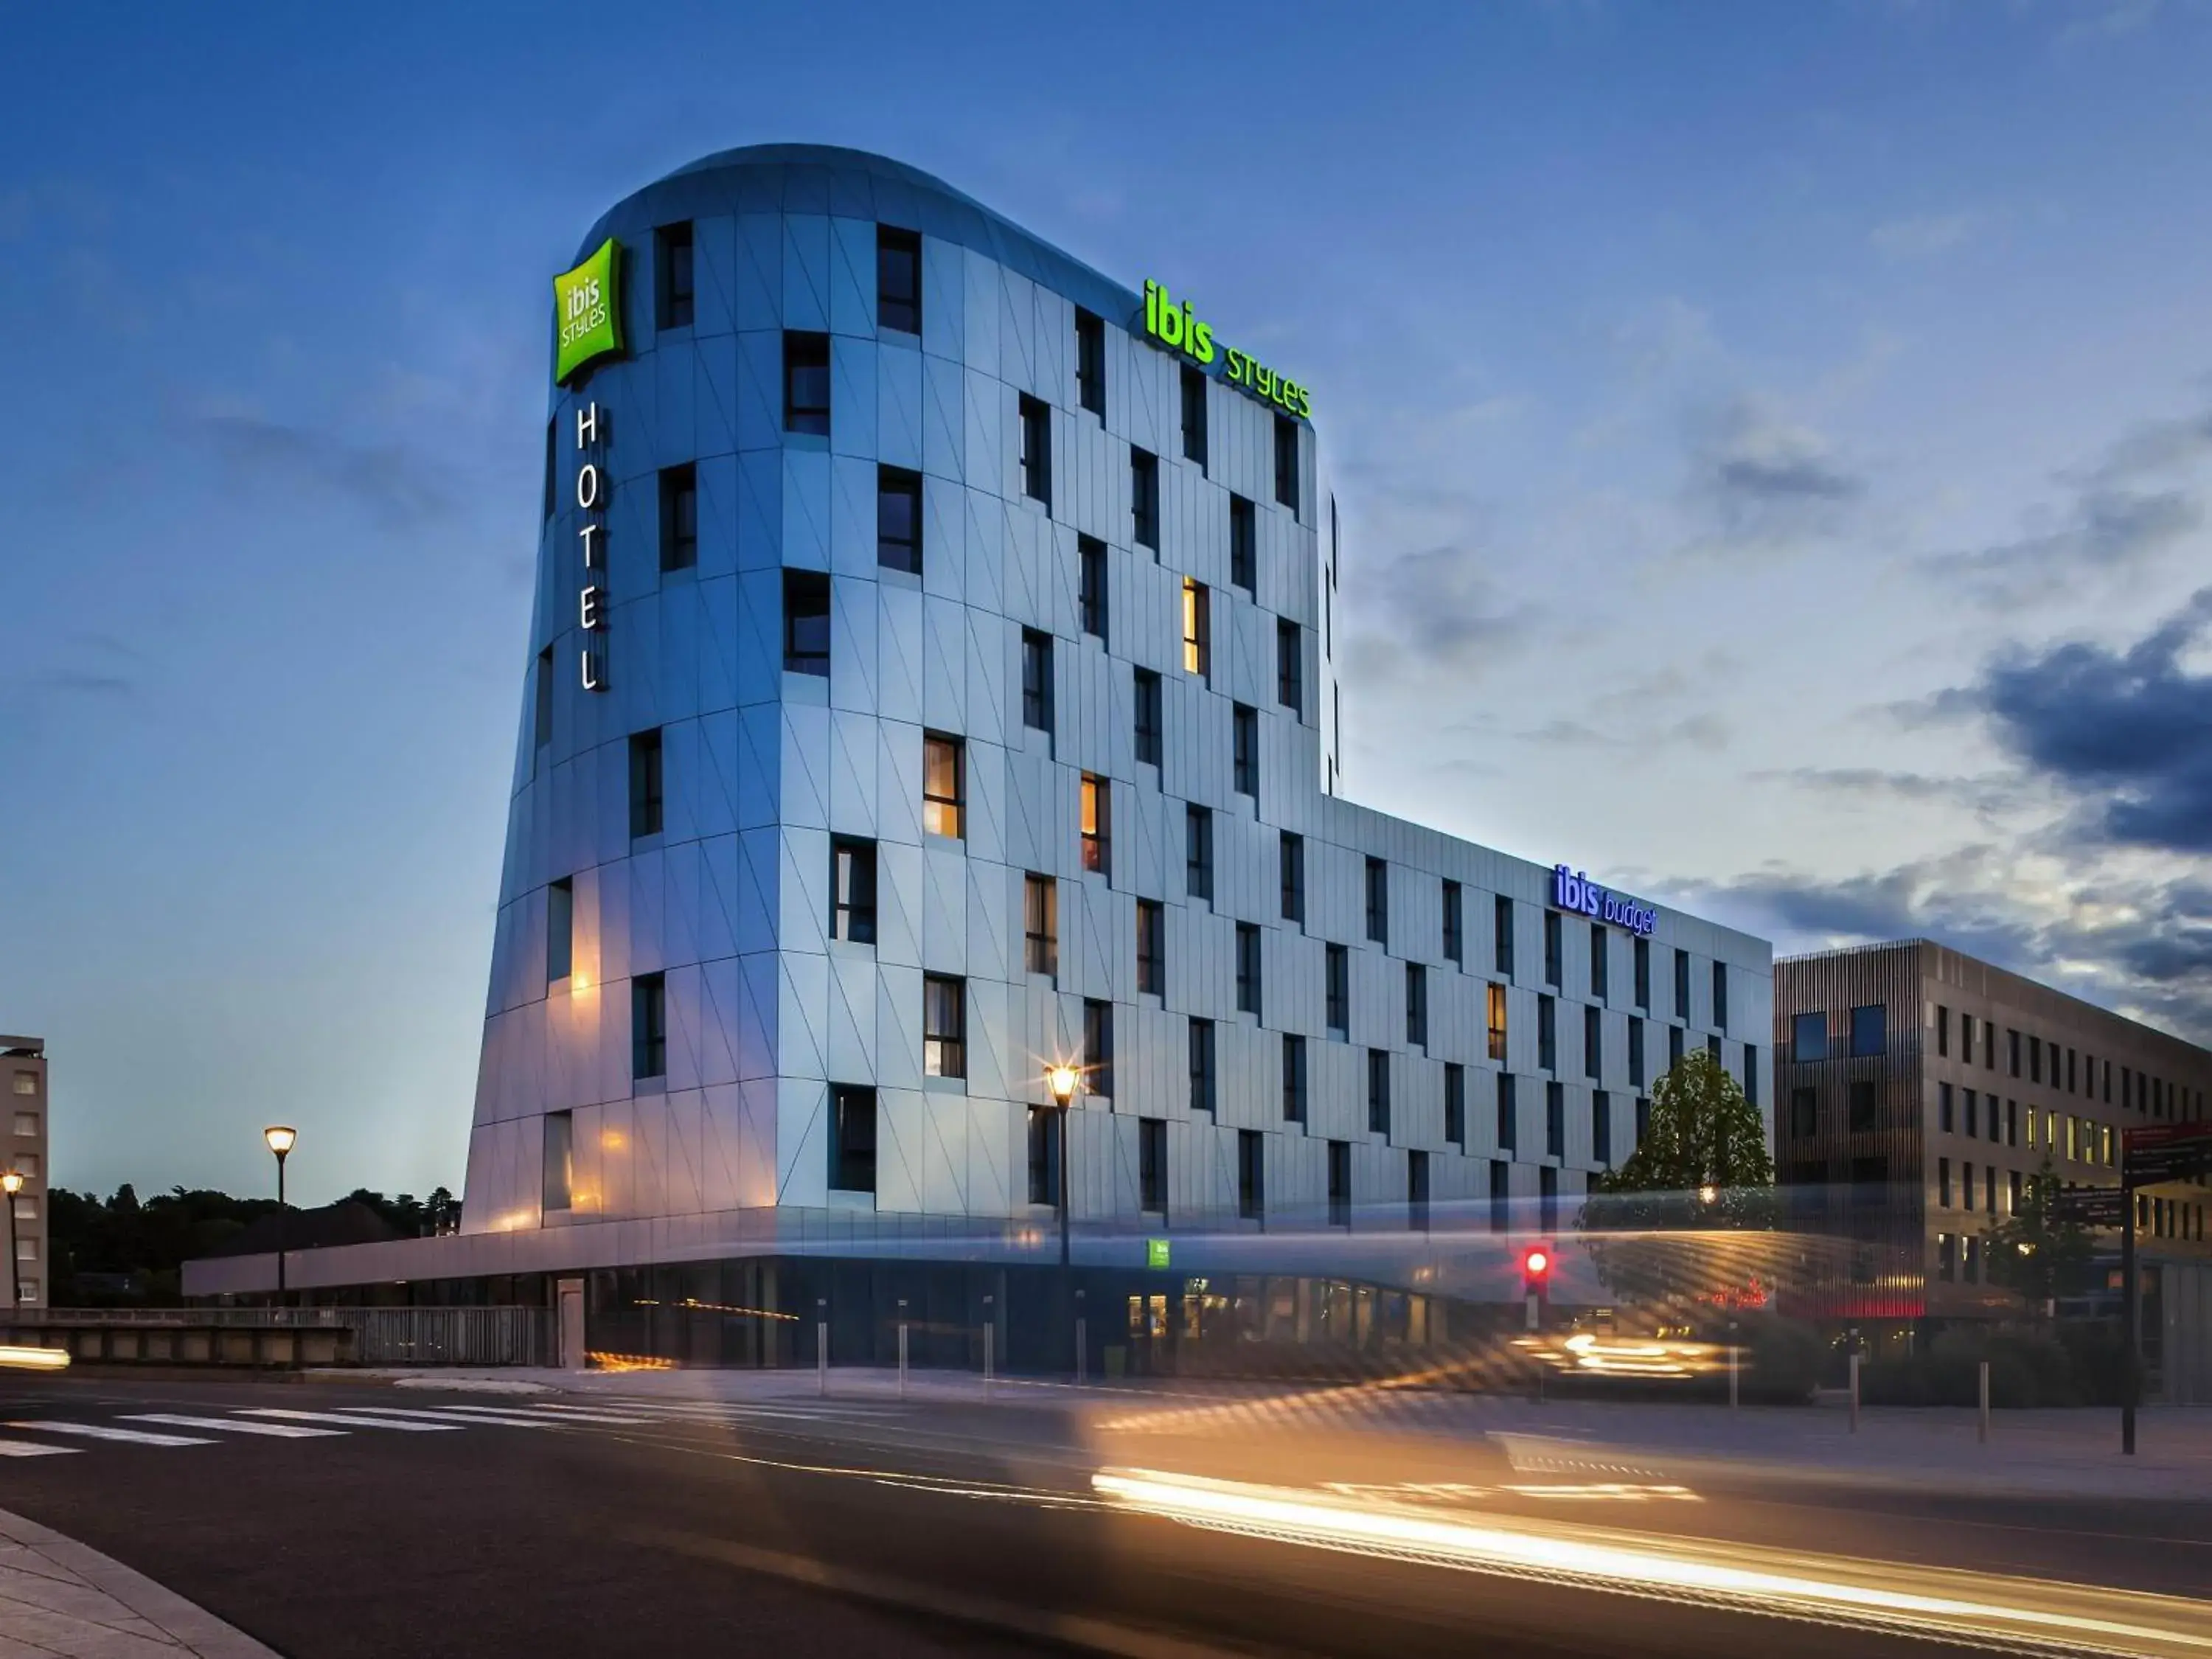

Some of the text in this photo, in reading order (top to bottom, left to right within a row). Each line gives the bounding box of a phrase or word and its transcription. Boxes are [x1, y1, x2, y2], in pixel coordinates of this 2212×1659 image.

[568, 276, 599, 320] ibis
[1145, 278, 1214, 364] ibis
[577, 402, 597, 690] HOTEL
[1556, 865, 1656, 936] ibis budget
